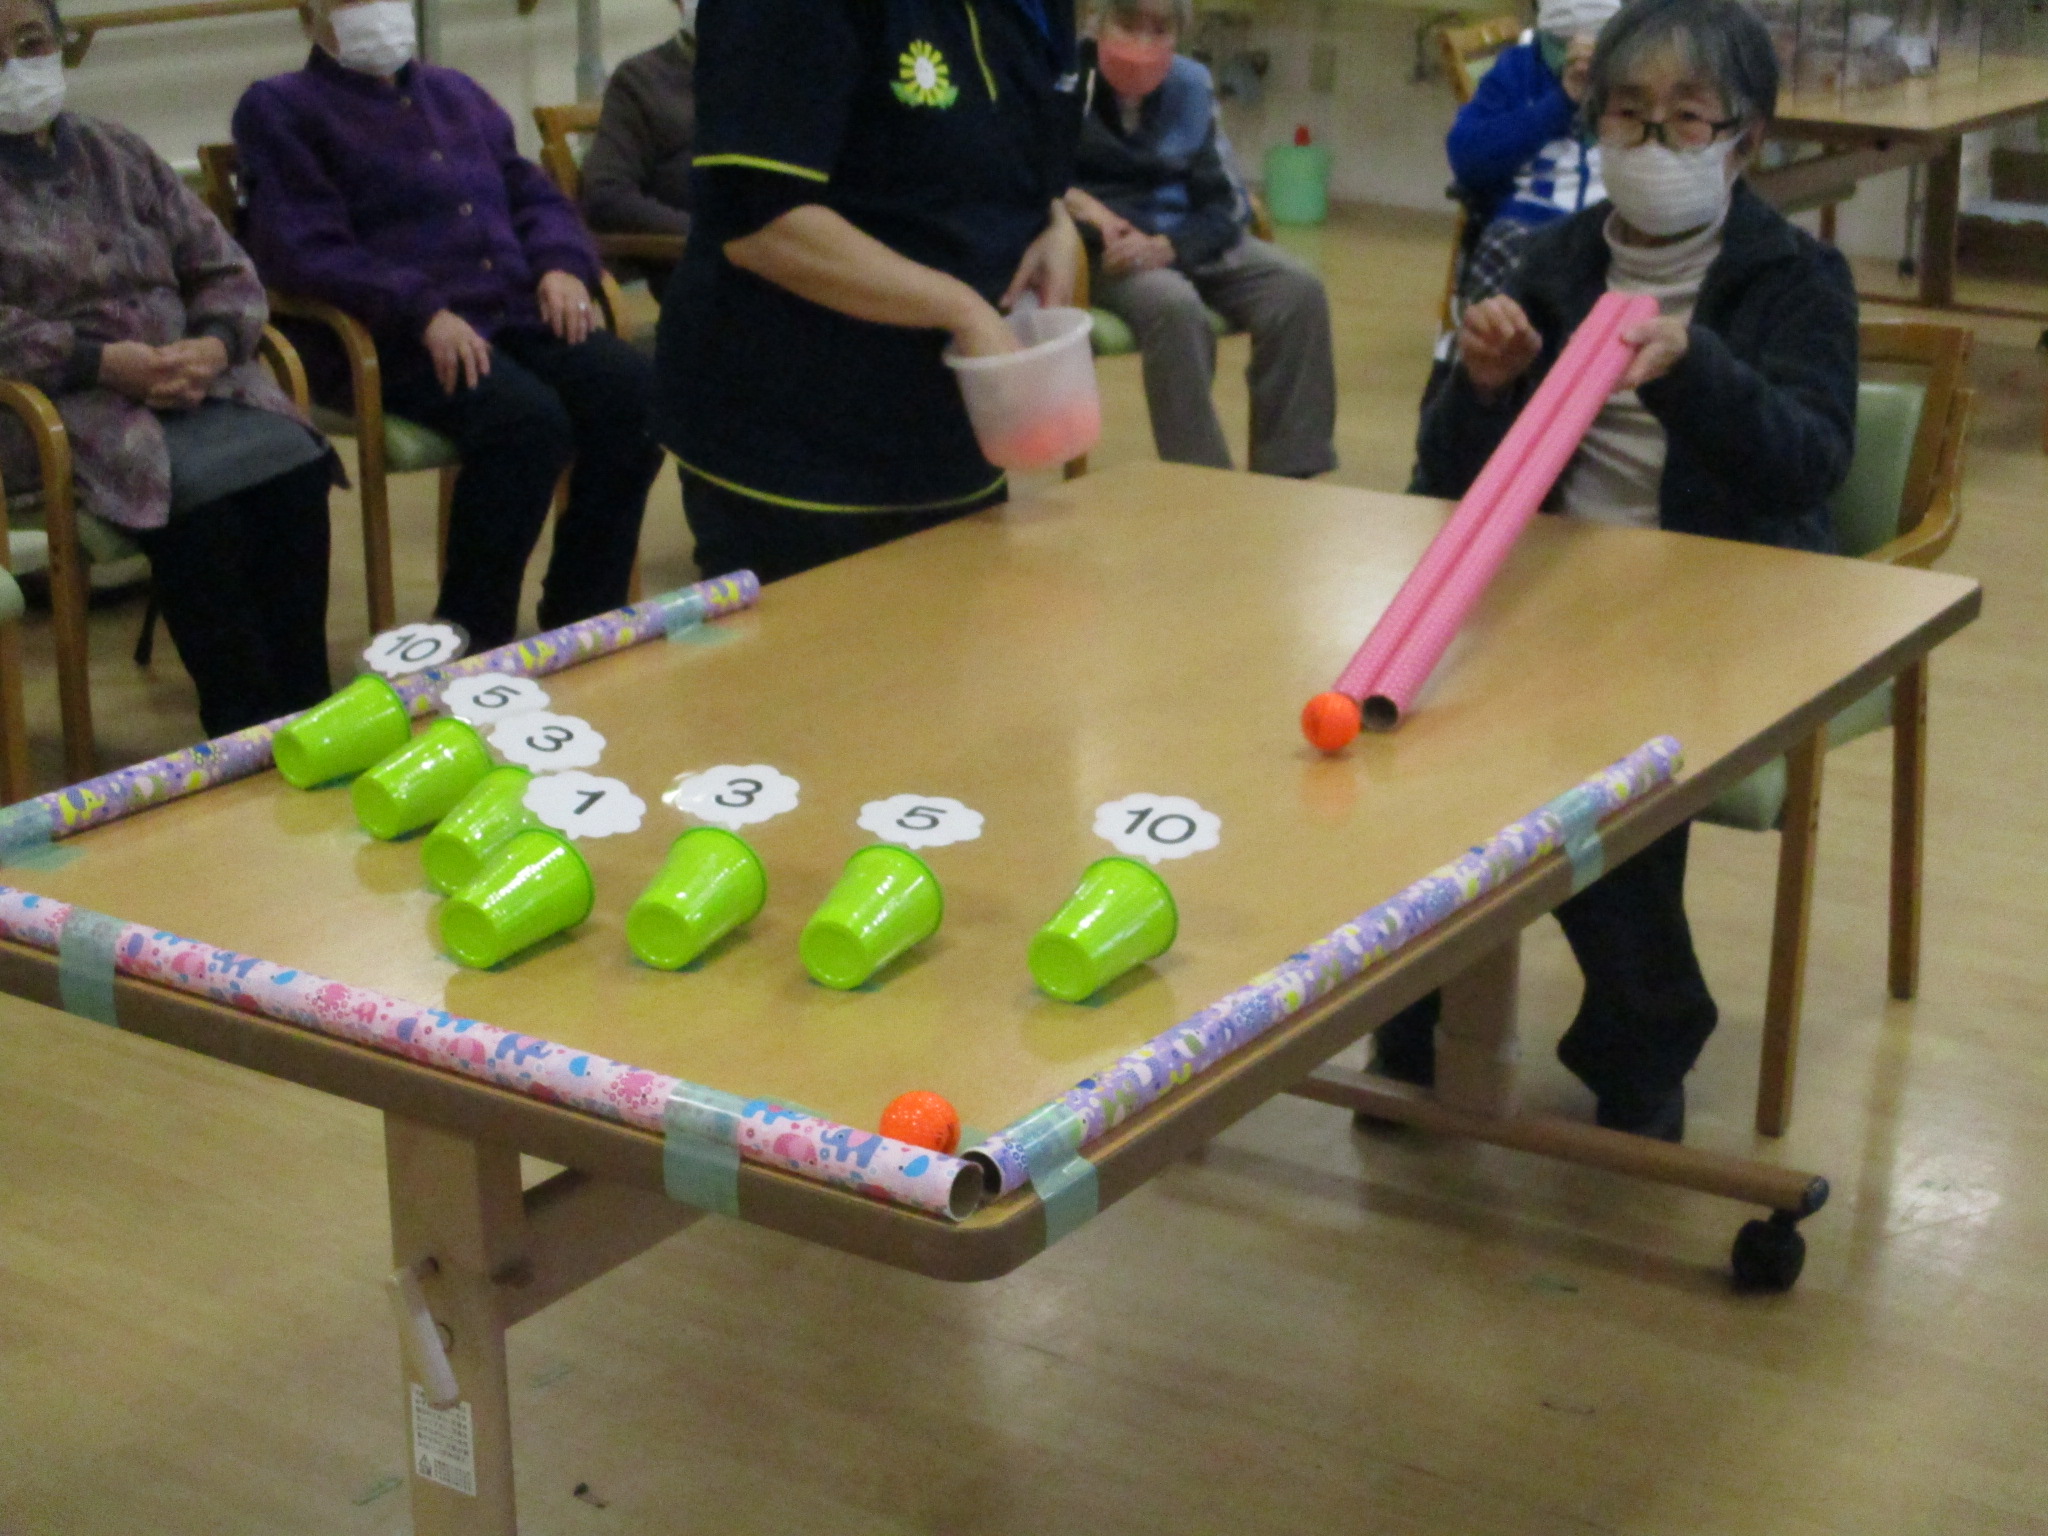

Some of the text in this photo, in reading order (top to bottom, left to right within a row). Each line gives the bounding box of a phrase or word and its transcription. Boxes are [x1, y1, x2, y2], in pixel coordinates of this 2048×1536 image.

[385, 632, 441, 663] 10
[473, 685, 521, 709] 5
[526, 725, 574, 753] 3
[573, 790, 606, 815] 1
[715, 778, 763, 807] 3
[896, 806, 947, 830] 5
[1122, 806, 1196, 845] 10
